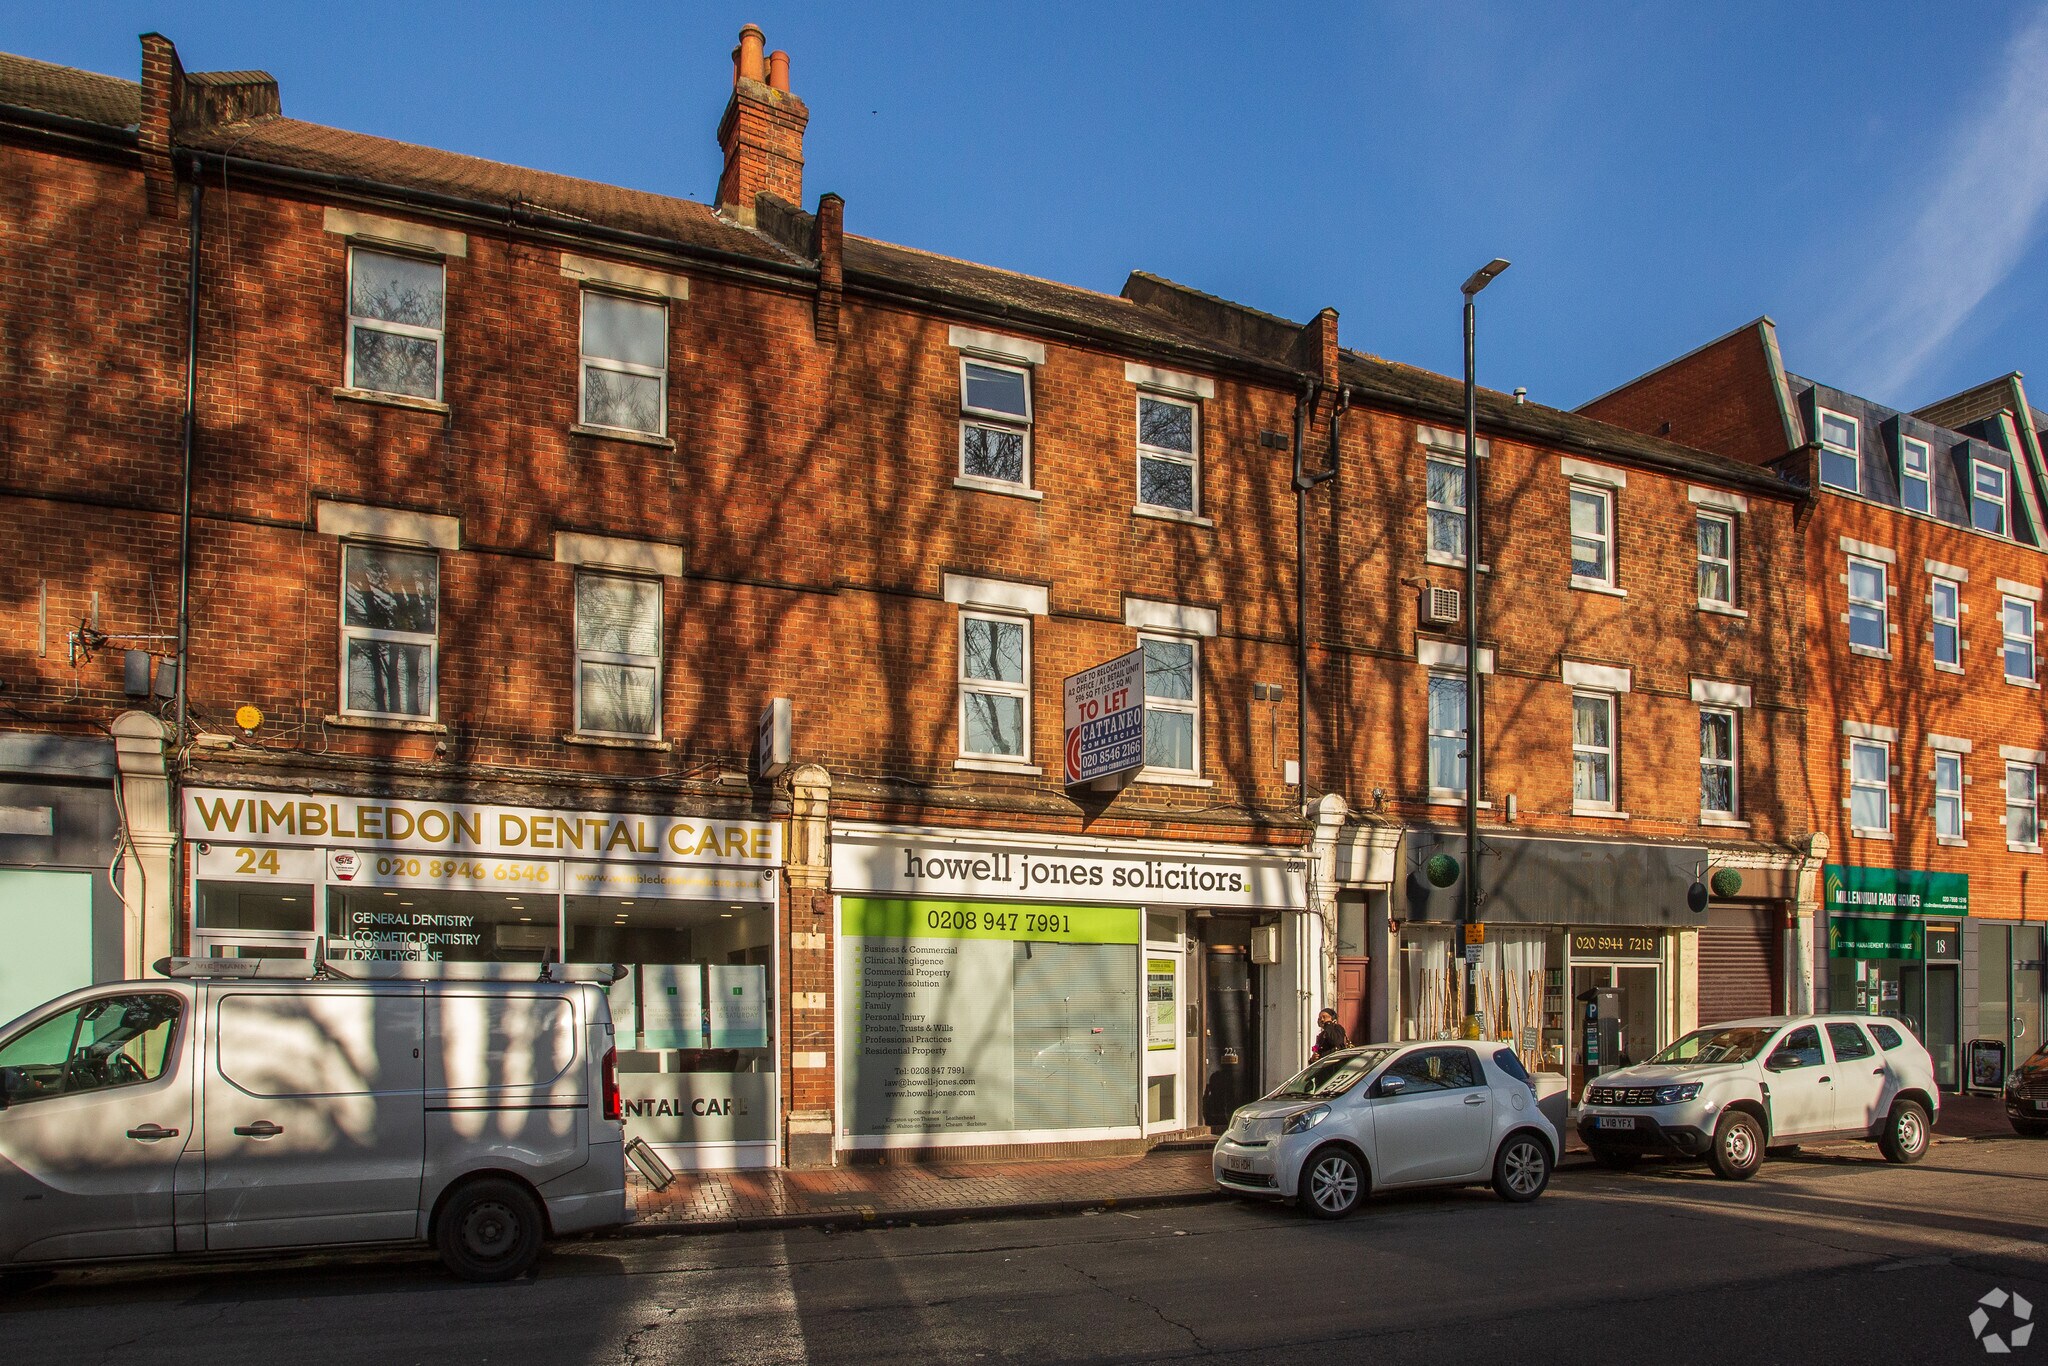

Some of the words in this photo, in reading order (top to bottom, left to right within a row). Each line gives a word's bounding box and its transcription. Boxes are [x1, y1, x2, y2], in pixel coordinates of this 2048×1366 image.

[1076, 674, 1088, 685] DUE
[1088, 671, 1096, 681] TO
[1096, 657, 1131, 677] RELOCATION
[1076, 680, 1094, 693] OFFICE
[1107, 669, 1125, 682] RETAIL
[1126, 662, 1140, 675] UNIT
[1085, 690, 1094, 699] SQ
[1094, 687, 1101, 696] FT
[1116, 678, 1124, 688] SQ
[1078, 699, 1099, 722] TO
[1104, 687, 1129, 714] LET
[1082, 708, 1141, 742] CATTANEO
[1082, 727, 1141, 750] COMMERCIAL
[1082, 753, 1098, 769] 020
[1099, 746, 1121, 764] 8546
[1121, 740, 1141, 758] 2166
[194, 796, 482, 845] WIMBLEDON
[499, 814, 660, 854] DENTAL
[668, 823, 773, 860] CARE
[235, 848, 280, 875] 24
[1286, 862, 1299, 872] 22
[376, 857, 421, 877] 020
[429, 859, 487, 880] 8946
[493, 863, 550, 883] 6546
[904, 848, 1012, 882] howell
[1020, 854, 1103, 891] jones
[1836, 890, 1878, 905] MILLENNIUM
[1878, 892, 1897, 906] PARK
[1897, 894, 1920, 907] HOMES
[352, 912, 410, 925] GENERAL
[412, 914, 475, 927] DENTISTRY
[927, 909, 977, 931] 0208
[983, 911, 1019, 932] 947
[1026, 914, 1070, 933] 7991
[352, 931, 417, 943] COSMETIC
[420, 933, 481, 946] DENTISTRY
[1576, 936, 1596, 949] 020
[1598, 937, 1624, 950] 8944
[1629, 937, 1654, 951] 7218
[1936, 939, 1946, 953] 18
[864, 945, 899, 953] Business
[909, 946, 958, 954] Commercial
[864, 956, 896, 964] Clinical
[898, 957, 944, 966] Negligence
[864, 967, 914, 976] Commercial
[916, 969, 951, 978] Property
[864, 979, 896, 988] Dispute
[898, 980, 940, 988] Resolution
[865, 991, 916, 1000] Employment
[865, 1002, 891, 1011] Family
[1589, 1003, 1597, 1018] P
[865, 1013, 899, 1021] Personal
[901, 1013, 926, 1022] Injury
[865, 1024, 899, 1033] Probate,
[900, 1024, 925, 1032] Trusts
[926, 1024, 932, 1032] &
[933, 1024, 953, 1032] Wills
[865, 1035, 914, 1044] Professional
[916, 1035, 952, 1043] Practices
[865, 1047, 910, 1055] Residential
[912, 1047, 947, 1056] Property
[895, 1067, 909, 1075] Tel:
[947, 1066, 965, 1074] 7991
[884, 1078, 976, 1088] law@howell-jones.com
[884, 1089, 976, 1098] www.howell-jones.com
